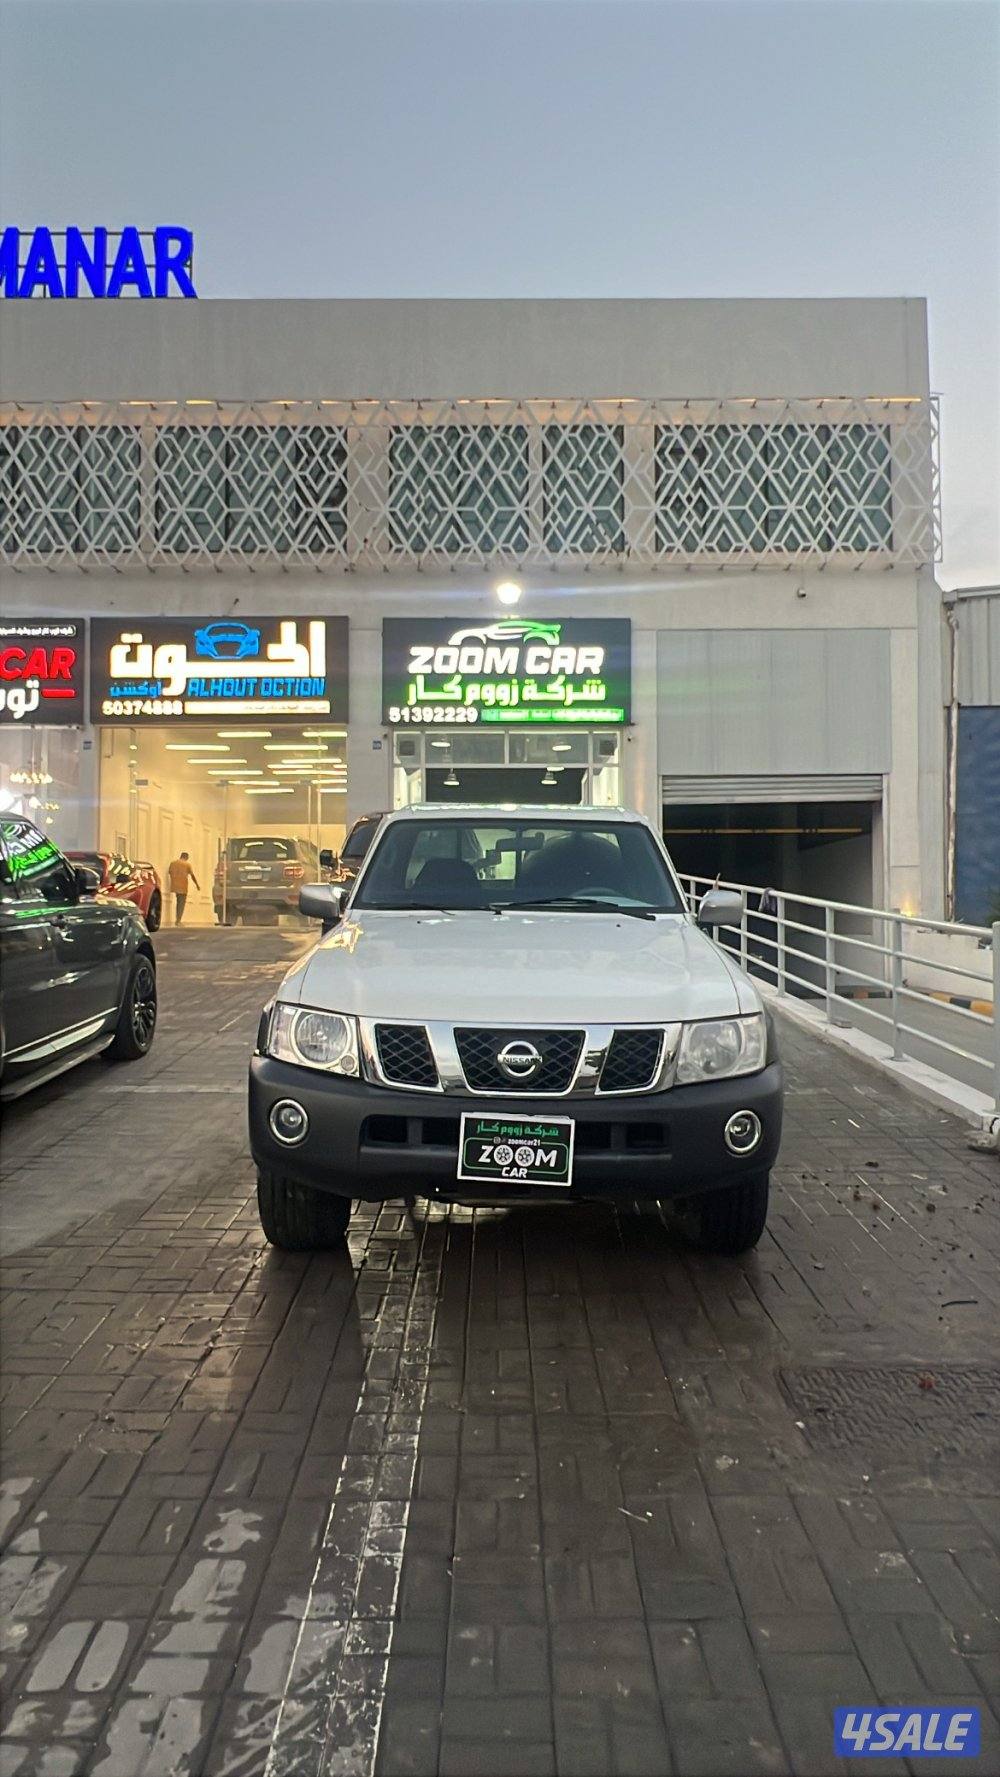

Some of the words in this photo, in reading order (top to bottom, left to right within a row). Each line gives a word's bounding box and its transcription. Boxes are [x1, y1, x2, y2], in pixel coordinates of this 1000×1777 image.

[0, 647, 76, 680] CAR
[408, 646, 519, 674] ZOOM
[526, 646, 604, 674] CAR
[187, 678, 257, 697] ALHOUT
[261, 678, 325, 697] OCTION
[407, 675, 462, 706] كار
[463, 679, 519, 706] زووم
[522, 675, 606, 706] شركة
[389, 707, 478, 722] 51392229
[503, 1056, 541, 1065] NISSAN
[478, 1145, 558, 1167] ZOOM
[501, 1166, 528, 1178] CAR
